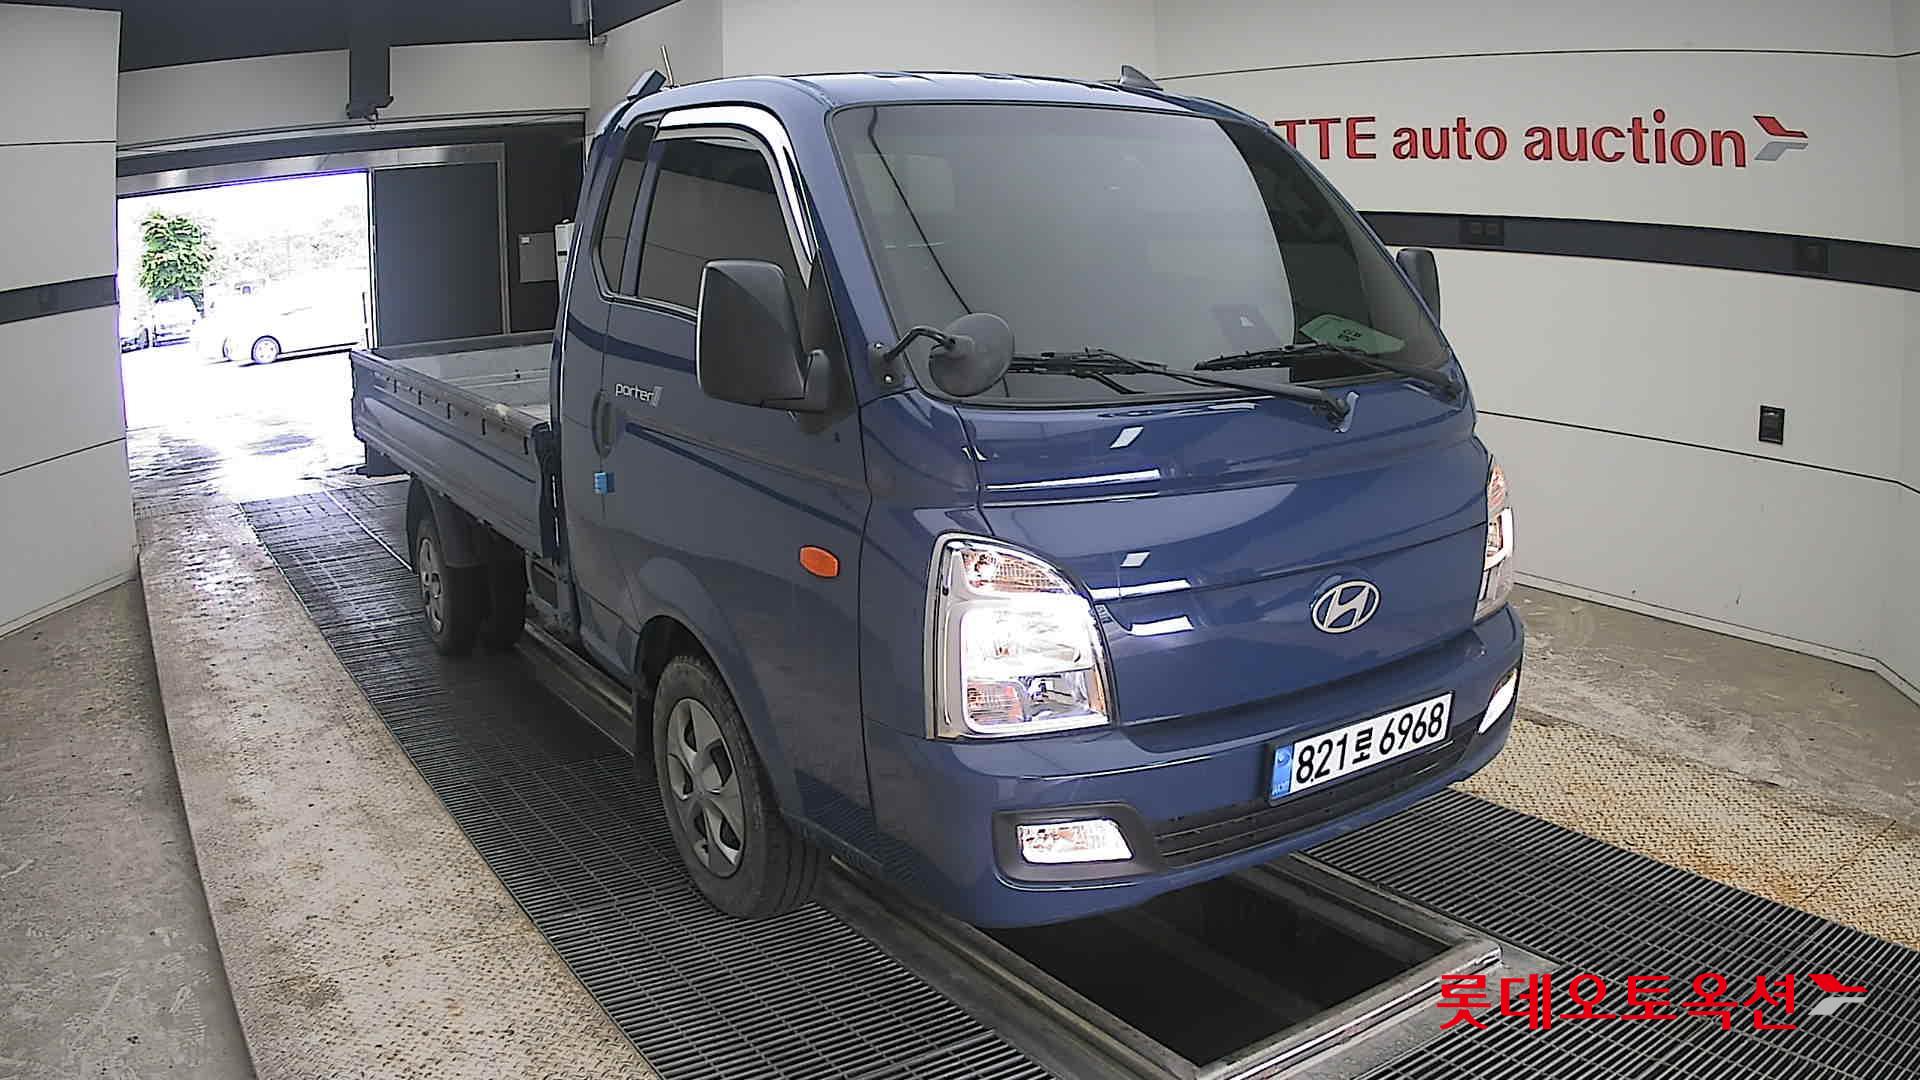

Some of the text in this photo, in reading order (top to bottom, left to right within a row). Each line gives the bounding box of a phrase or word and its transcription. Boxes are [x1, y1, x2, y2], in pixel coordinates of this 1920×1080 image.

[1392, 116, 1508, 160] auto
[1523, 108, 1747, 169] auction
[615, 383, 655, 402] porter
[1379, 702, 1445, 756] 6968
